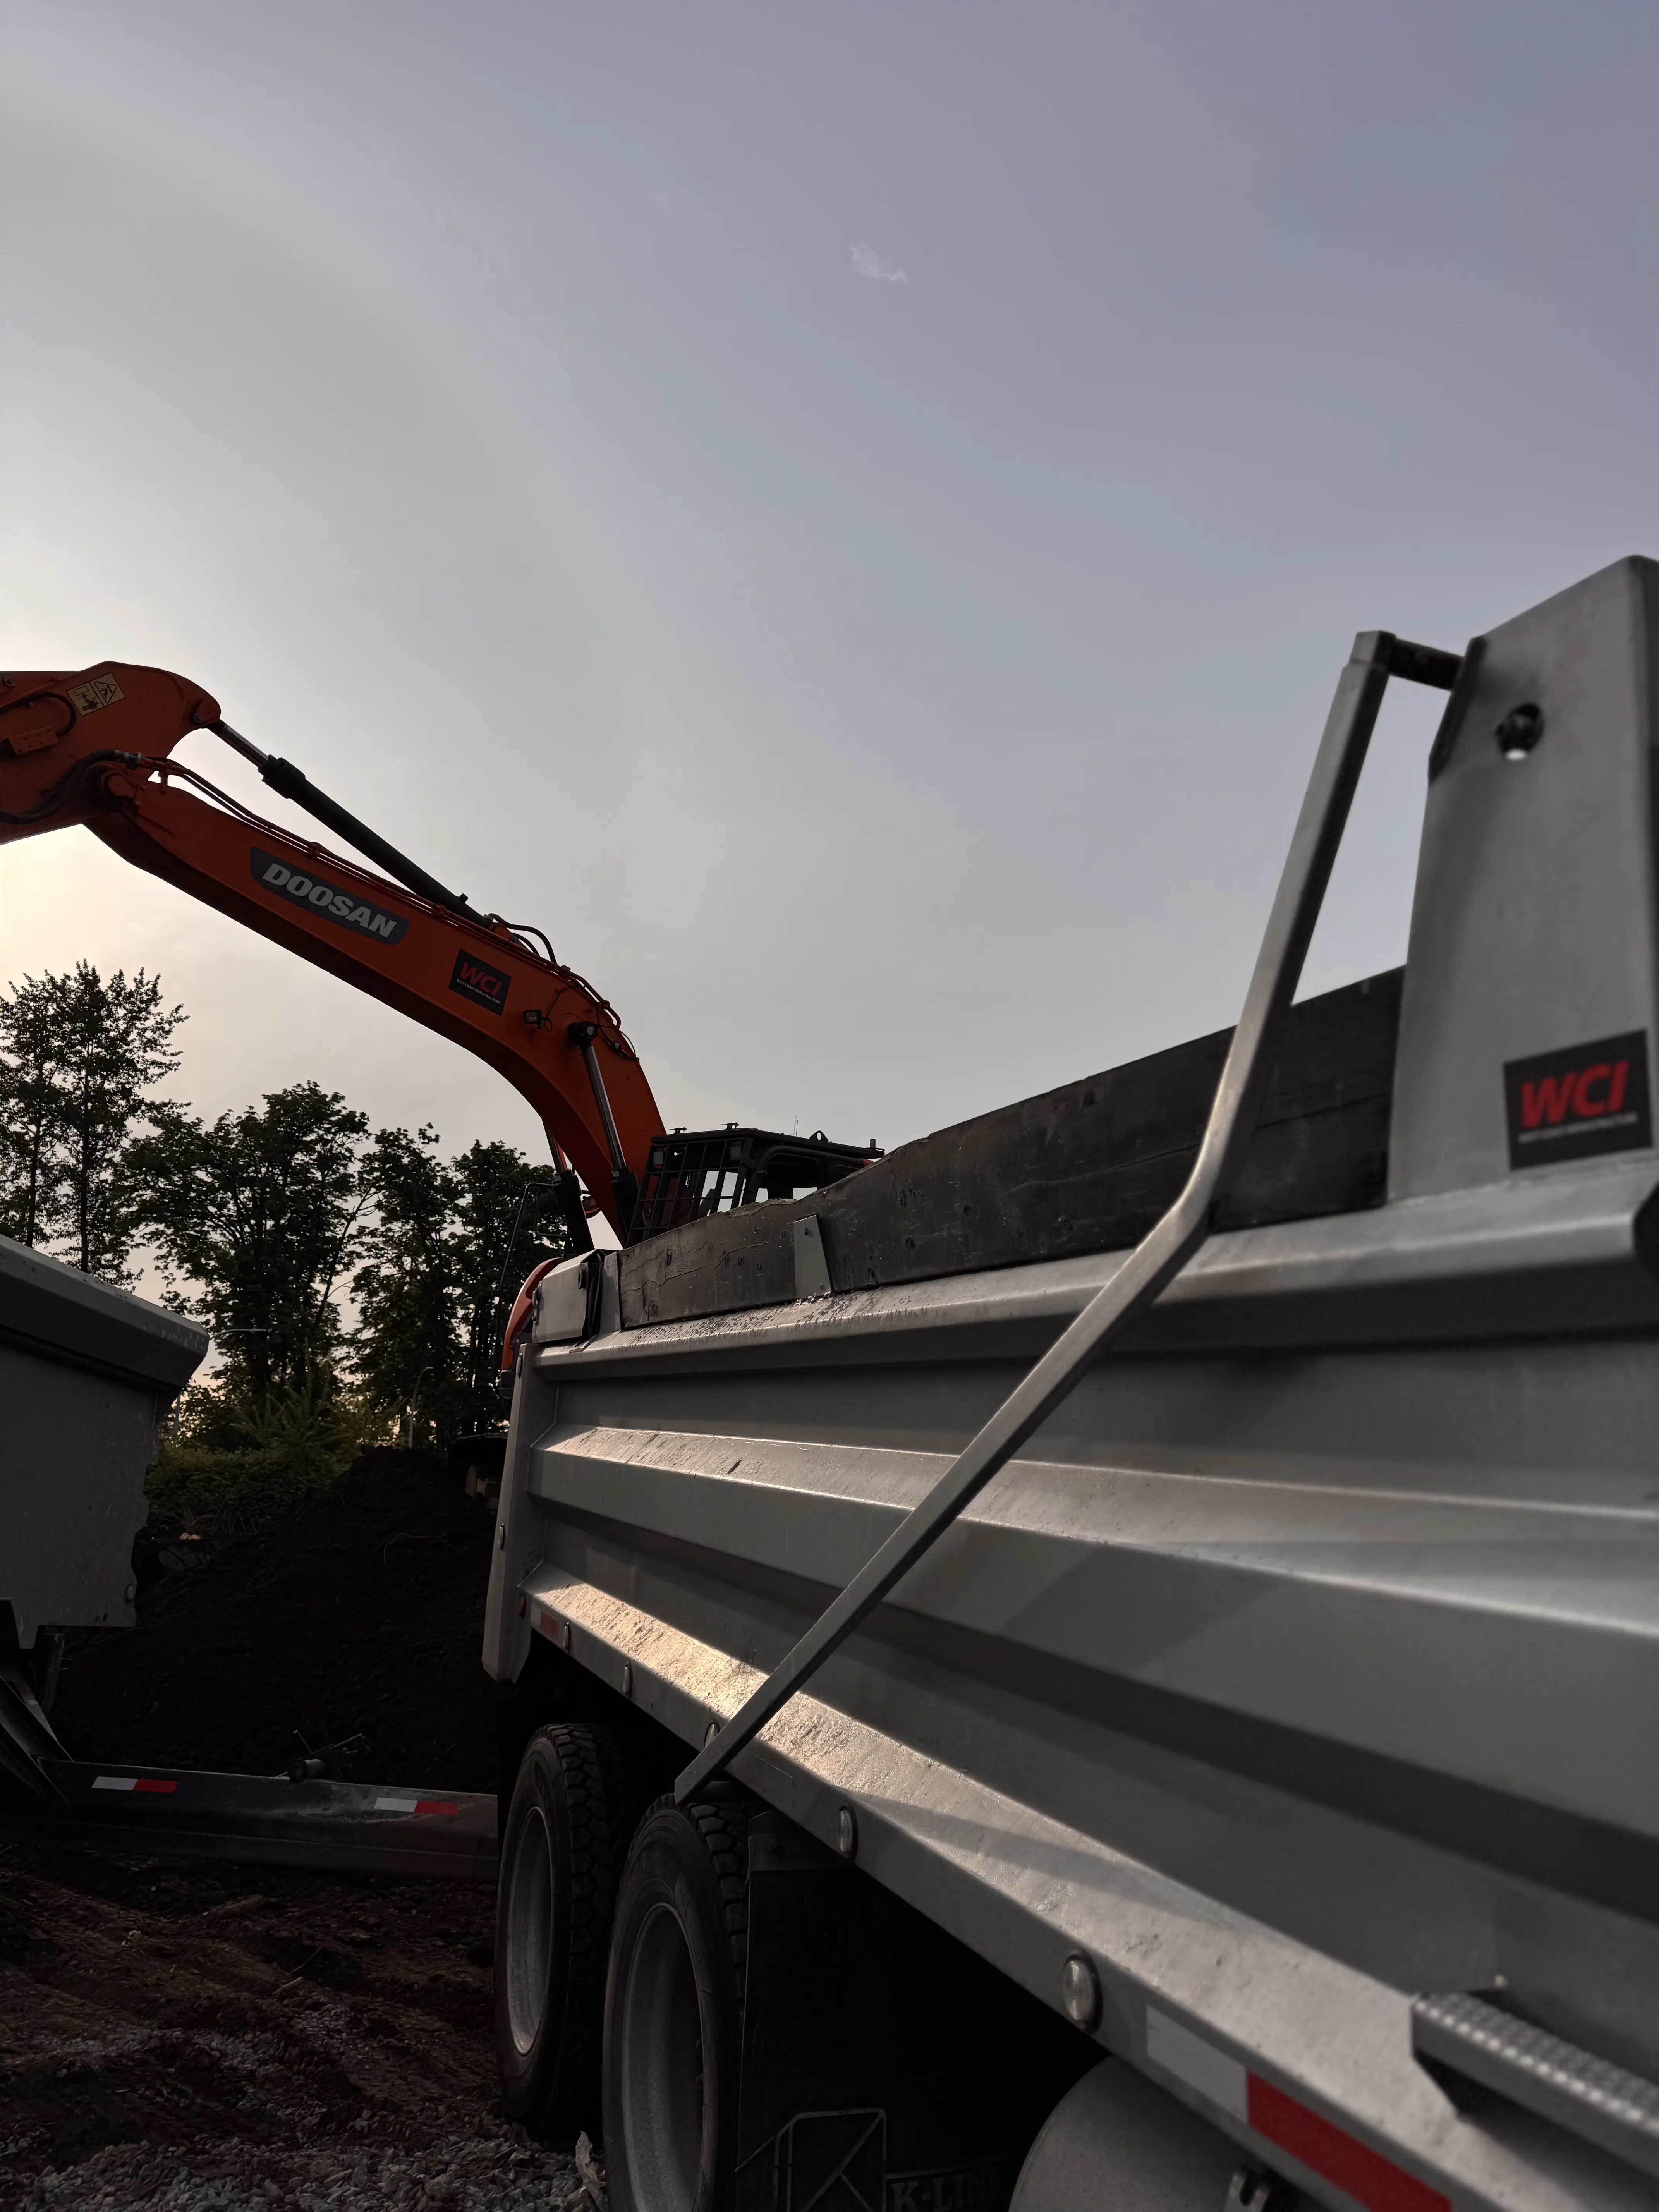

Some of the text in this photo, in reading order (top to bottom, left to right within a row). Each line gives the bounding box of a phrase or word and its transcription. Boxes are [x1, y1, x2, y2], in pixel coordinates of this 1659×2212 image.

[262, 863, 397, 938] DOOSAN
[459, 962, 503, 996] WCI
[1521, 1060, 1629, 1129] WCI
